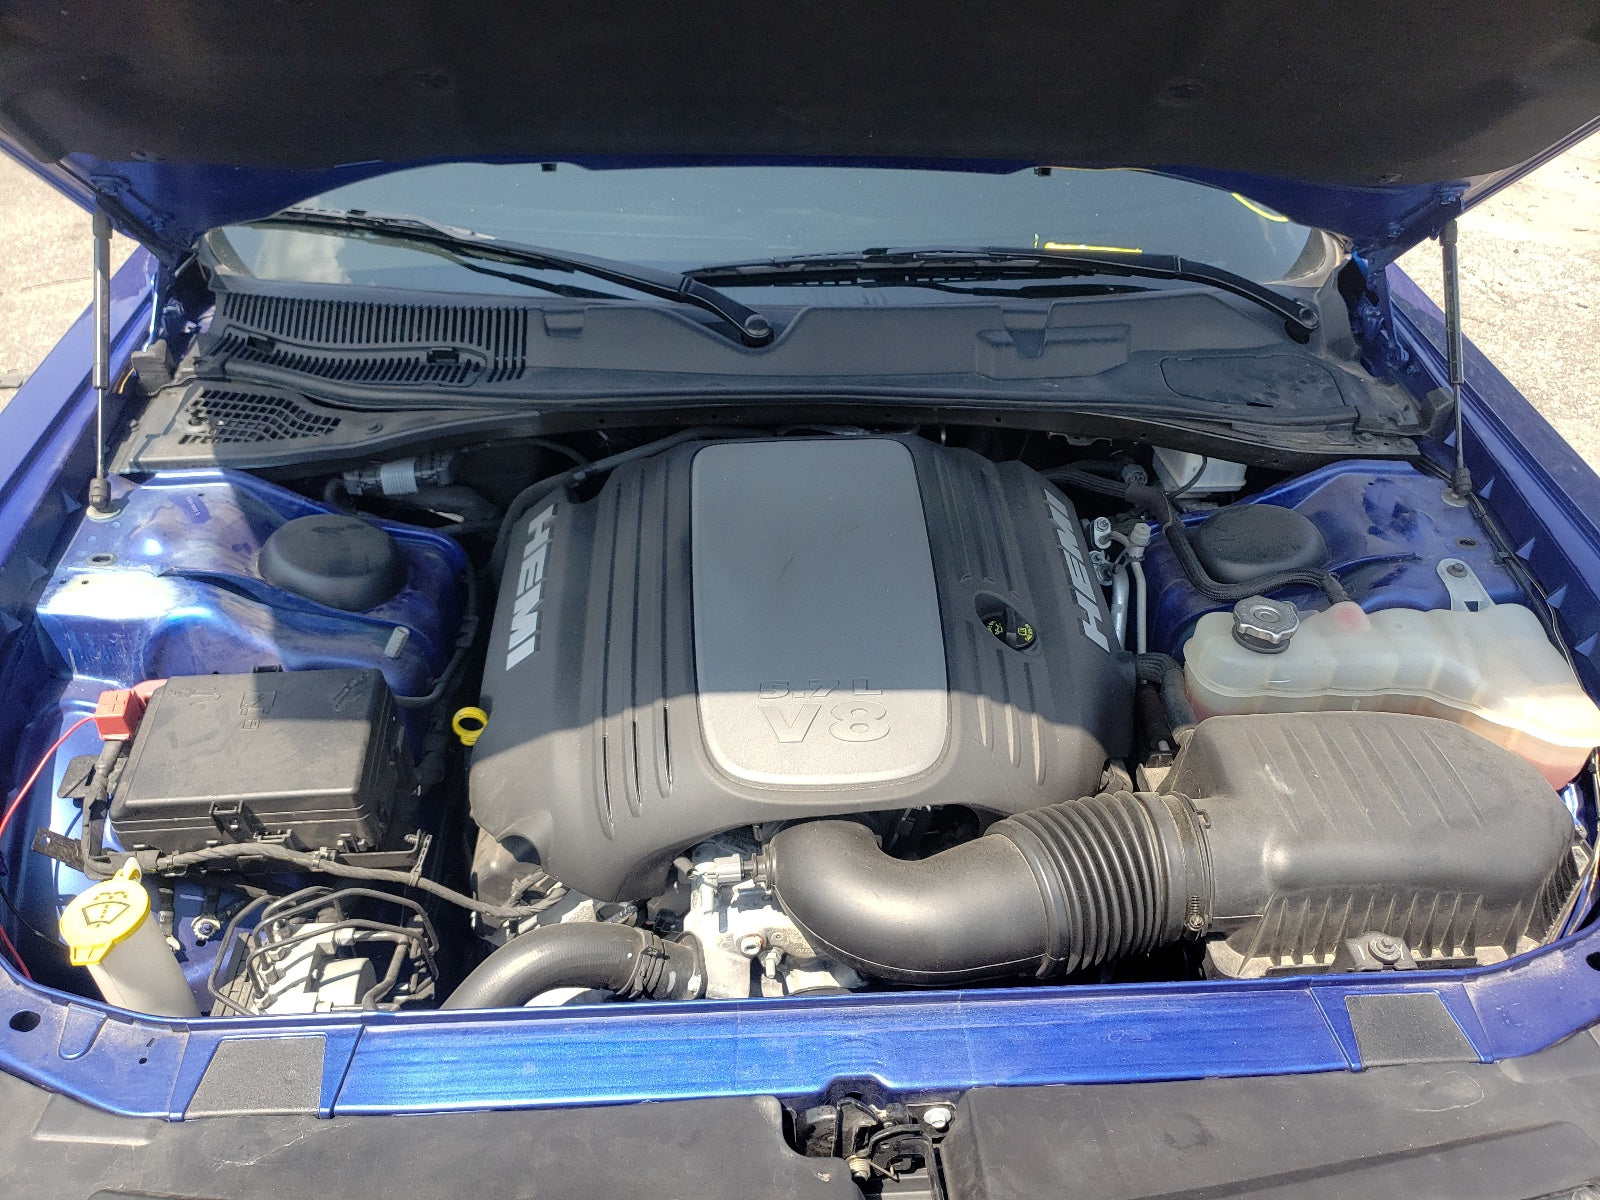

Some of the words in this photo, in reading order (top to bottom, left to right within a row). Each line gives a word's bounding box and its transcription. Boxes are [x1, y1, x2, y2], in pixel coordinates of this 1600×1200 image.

[505, 503, 555, 672] HEMI
[1043, 488, 1111, 653] HEMI
[757, 700, 891, 744] V8
